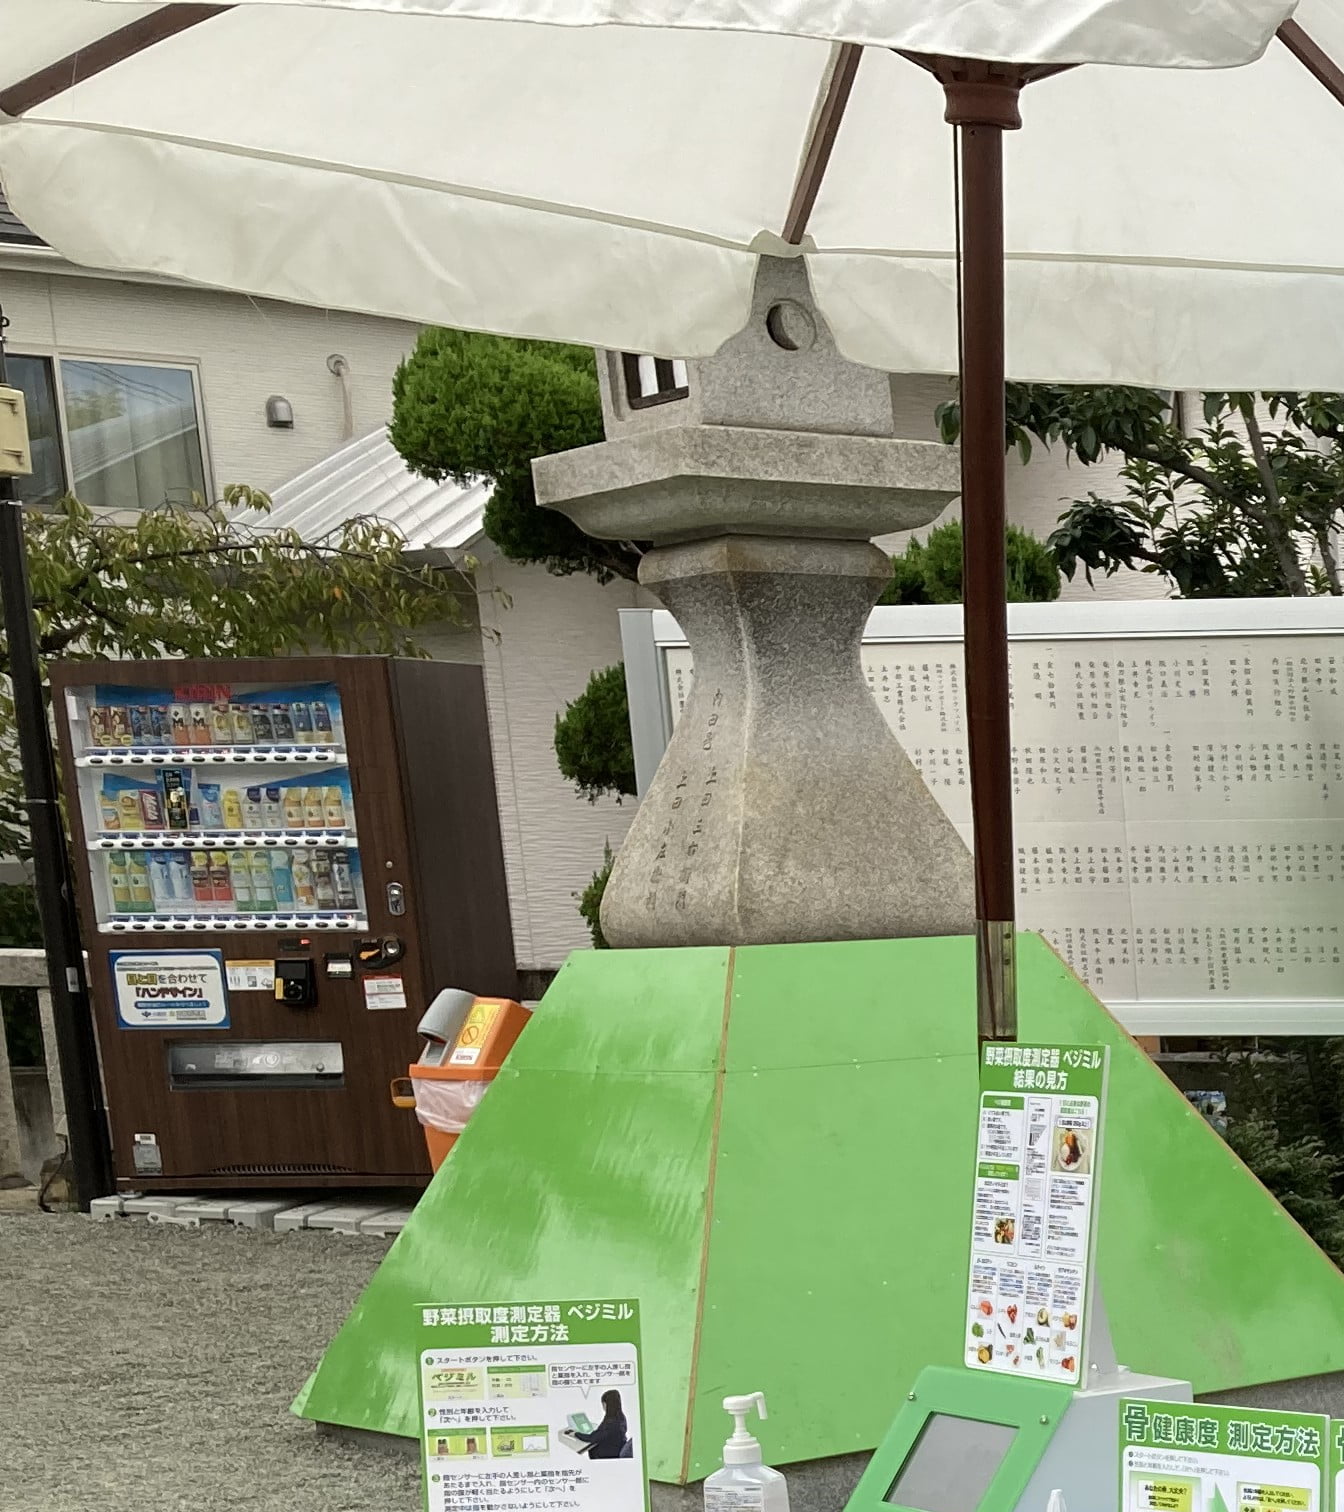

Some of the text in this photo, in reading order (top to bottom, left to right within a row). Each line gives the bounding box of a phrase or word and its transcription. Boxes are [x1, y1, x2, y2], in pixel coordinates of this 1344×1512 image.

[1013, 1069, 1068, 1090] 結果の見方
[567, 1303, 634, 1321] ベジミル
[489, 1324, 570, 1343] 測定方法
[1123, 1403, 1321, 1458] 骨健康度 測定方法
